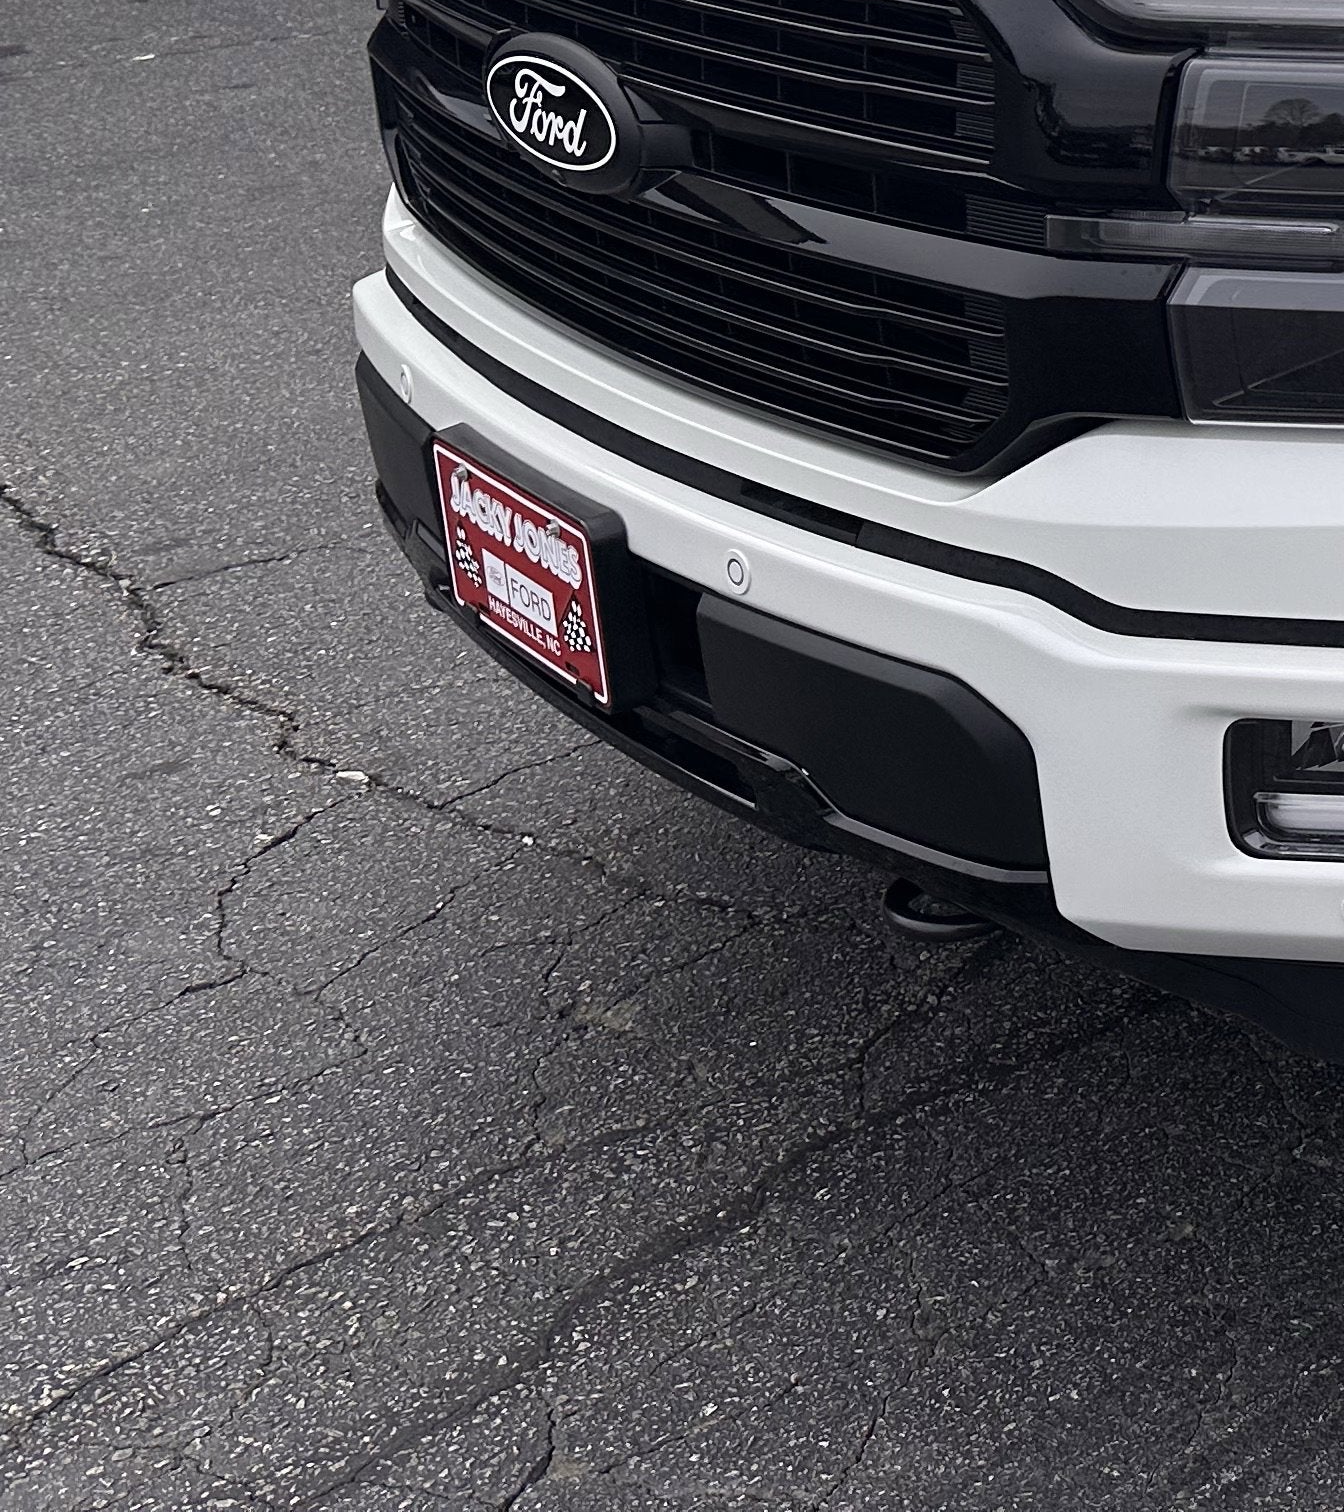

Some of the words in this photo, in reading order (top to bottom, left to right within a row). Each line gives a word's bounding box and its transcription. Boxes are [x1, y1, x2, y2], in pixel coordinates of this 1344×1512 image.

[509, 68, 587, 157] Ford
[450, 472, 512, 547] JACKY
[513, 514, 582, 590] JONES
[510, 576, 551, 621] FORD
[546, 635, 562, 656] NC
